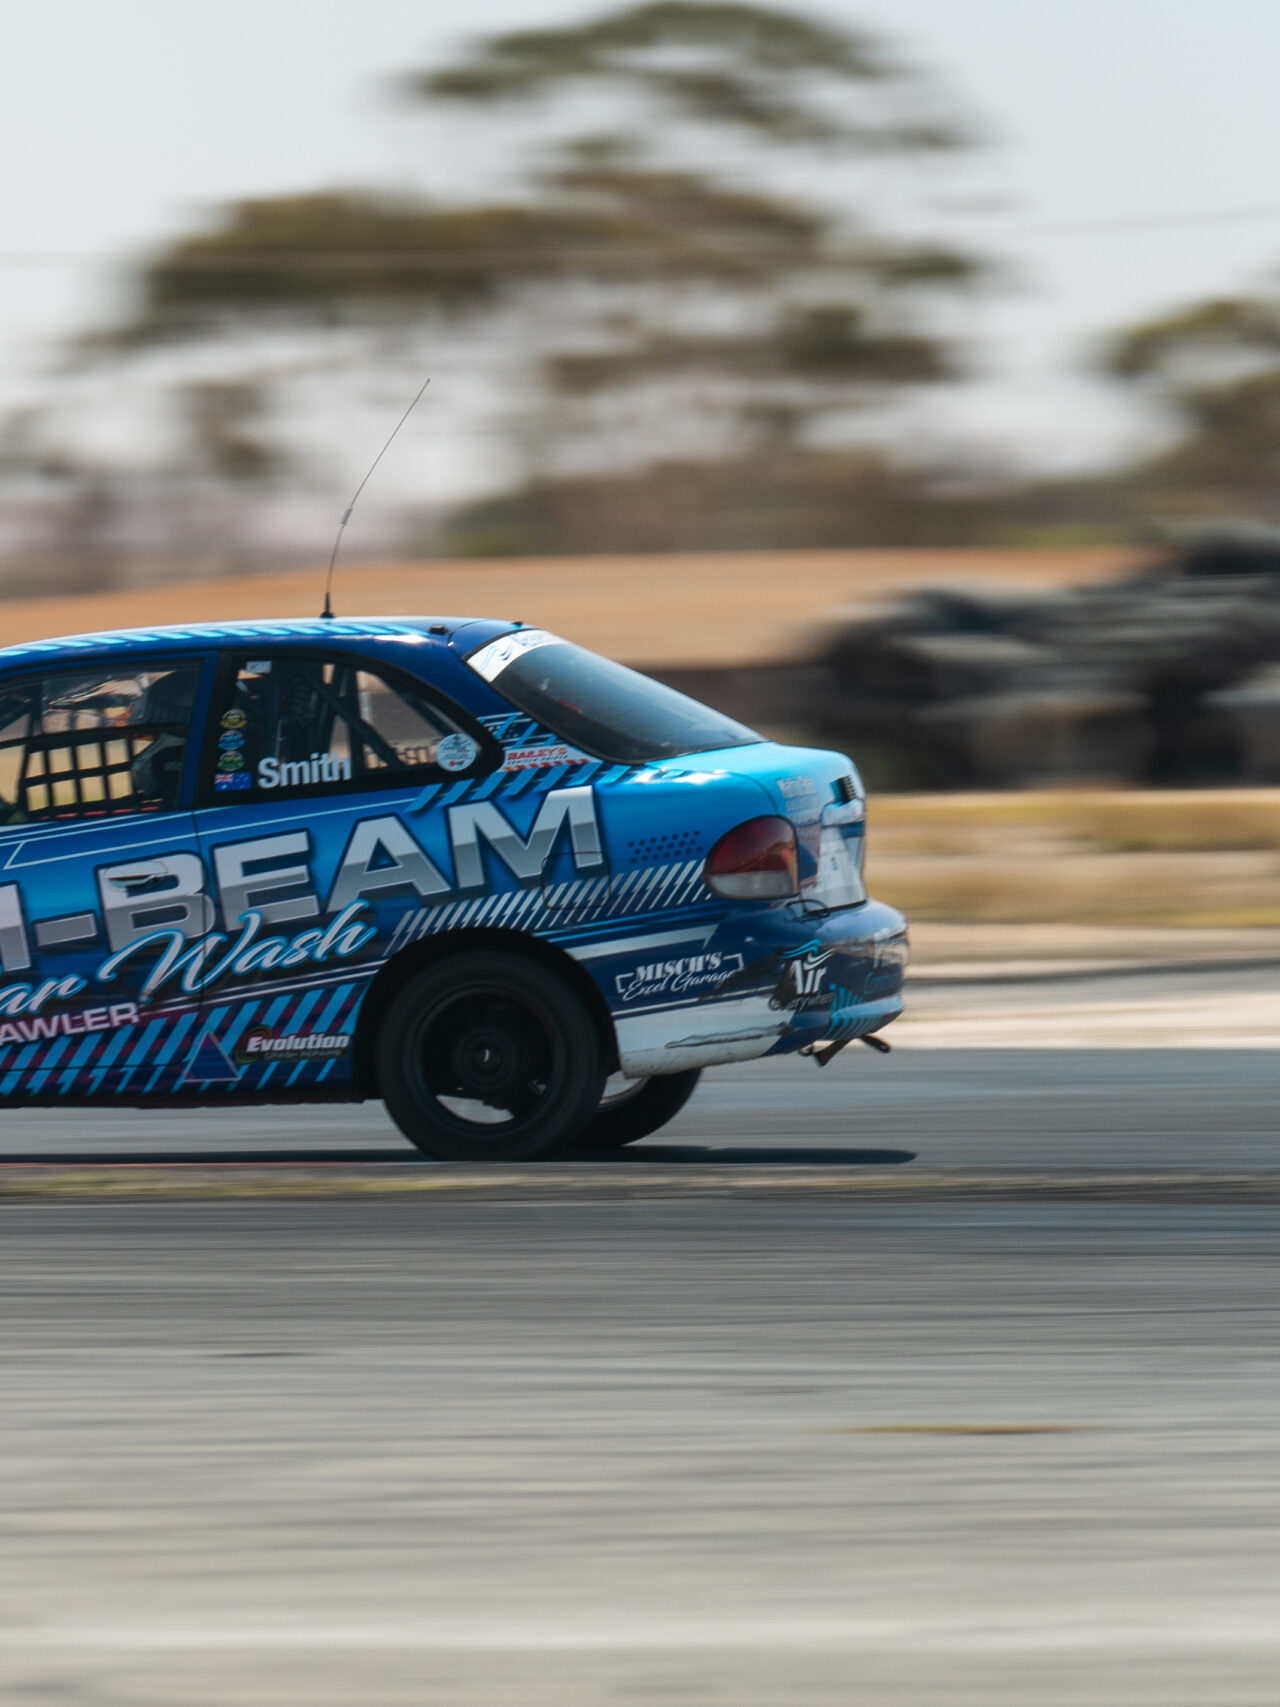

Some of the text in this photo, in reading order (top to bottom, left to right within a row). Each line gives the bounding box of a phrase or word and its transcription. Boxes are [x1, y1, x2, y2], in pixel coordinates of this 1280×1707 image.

[258, 752, 352, 789] Smith
[97, 898, 379, 1004] Wash
[635, 952, 723, 982] MISCH'S
[622, 972, 673, 1001] Excel
[245, 1033, 351, 1053] Evolution
